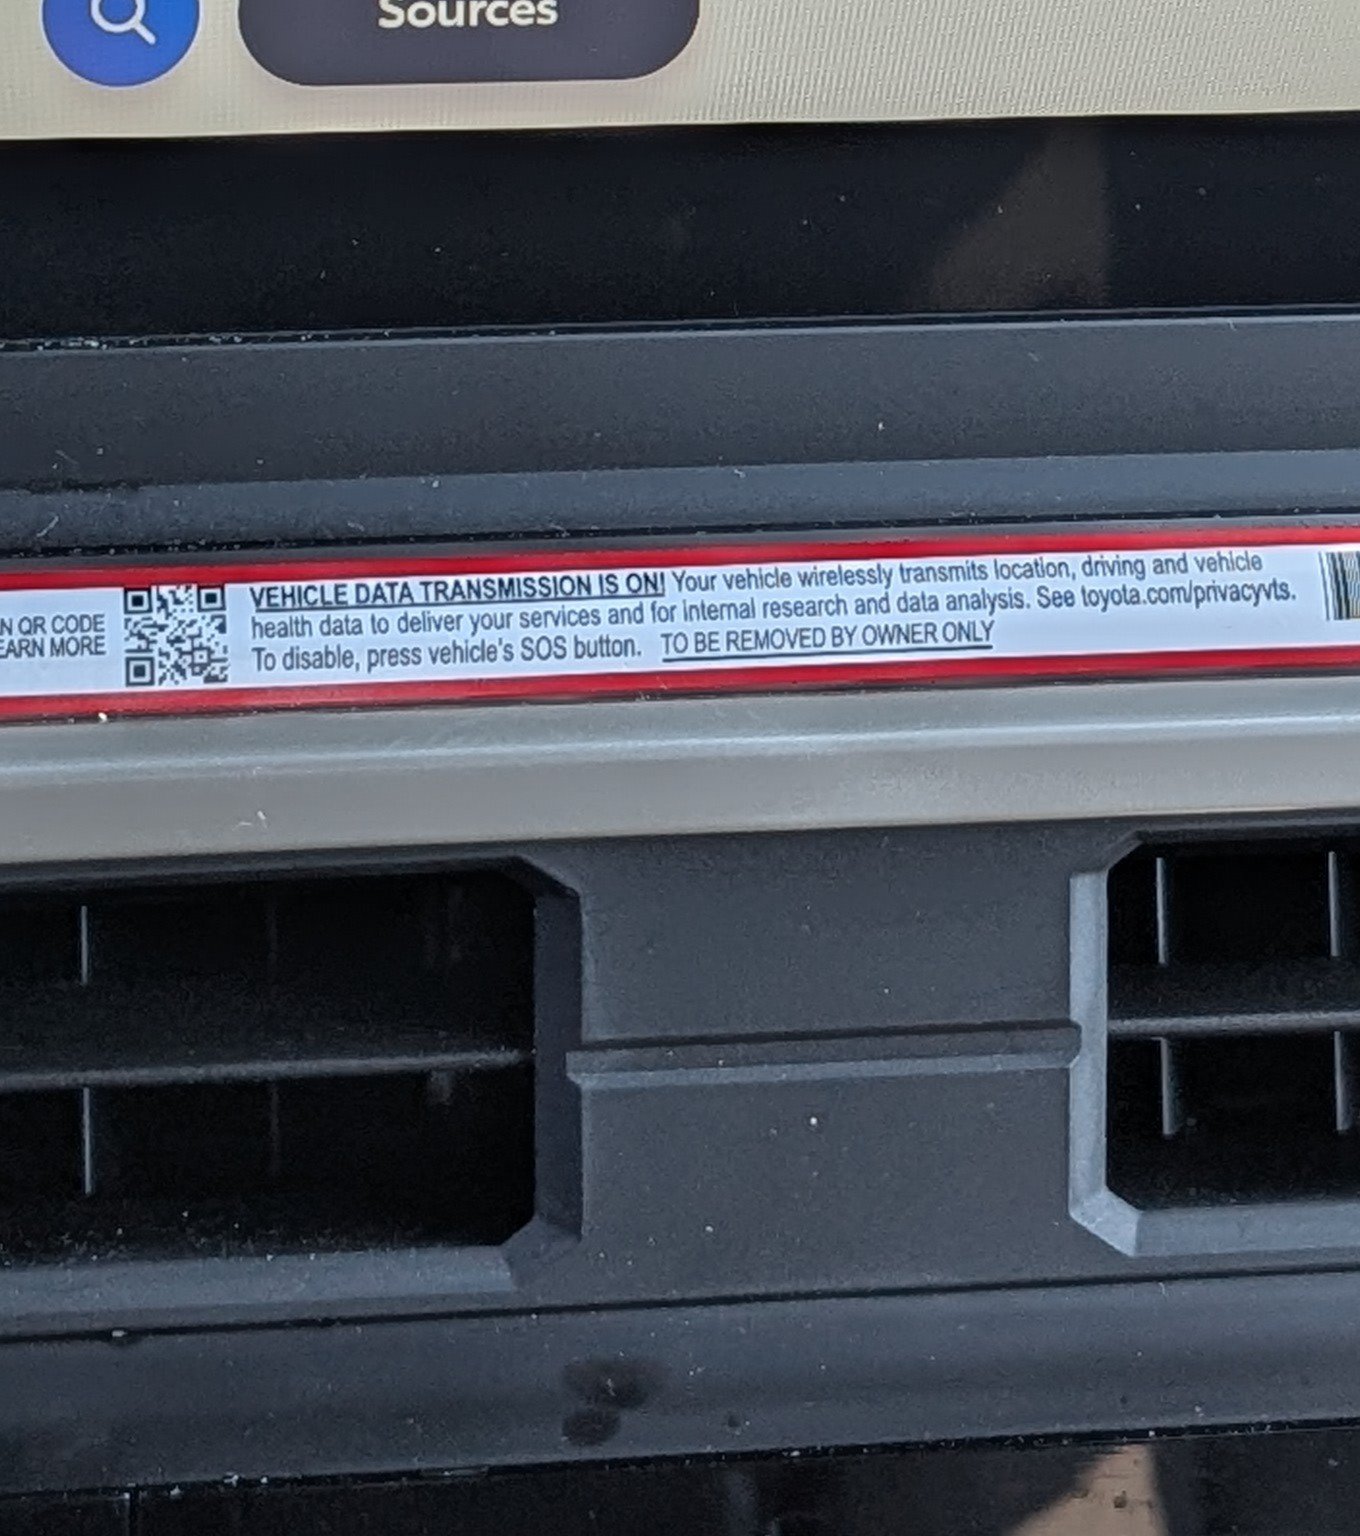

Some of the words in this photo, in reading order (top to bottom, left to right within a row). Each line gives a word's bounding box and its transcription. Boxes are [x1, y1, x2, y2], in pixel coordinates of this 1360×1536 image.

[250, 584, 348, 608] VEHICLE
[355, 581, 414, 604] DATA
[420, 575, 592, 602] TRANSMISSION
[599, 574, 619, 595] IS
[627, 572, 665, 594] ON!
[673, 570, 716, 591] Your
[724, 567, 792, 590] vehicle
[797, 564, 892, 590] wirelessly
[899, 560, 988, 583] transmits
[994, 557, 1076, 581] location,
[1081, 553, 1146, 580] driving
[1153, 553, 1188, 574] and
[1194, 550, 1263, 573] vehicle
[19, 615, 47, 635] QR
[52, 614, 106, 634] CODE
[251, 615, 313, 639] health
[319, 613, 363, 637] data
[370, 614, 389, 635] to
[397, 609, 462, 634] deliver
[470, 610, 512, 637] your
[519, 605, 601, 629] services
[608, 602, 643, 625] and
[651, 600, 676, 623] for
[683, 597, 756, 621] internal
[763, 594, 848, 618] research
[854, 591, 891, 614] and
[897, 590, 939, 612] data
[946, 588, 1030, 616] analysis.
[1036, 585, 1075, 608] See
[1081, 579, 1296, 612] toyota.com/privacyvts.
[50, 636, 106, 657] MORE
[252, 647, 276, 672] To
[282, 644, 360, 672] disable,
[366, 647, 422, 673] press
[428, 638, 514, 665] vehicle's
[521, 636, 567, 660] SOS
[574, 634, 642, 658] button.
[661, 632, 688, 654] TO
[695, 632, 719, 653] BE
[726, 627, 826, 651] REMOVED
[831, 625, 857, 647] BY
[862, 622, 937, 646] OWNER
[942, 620, 995, 642] ONLY
